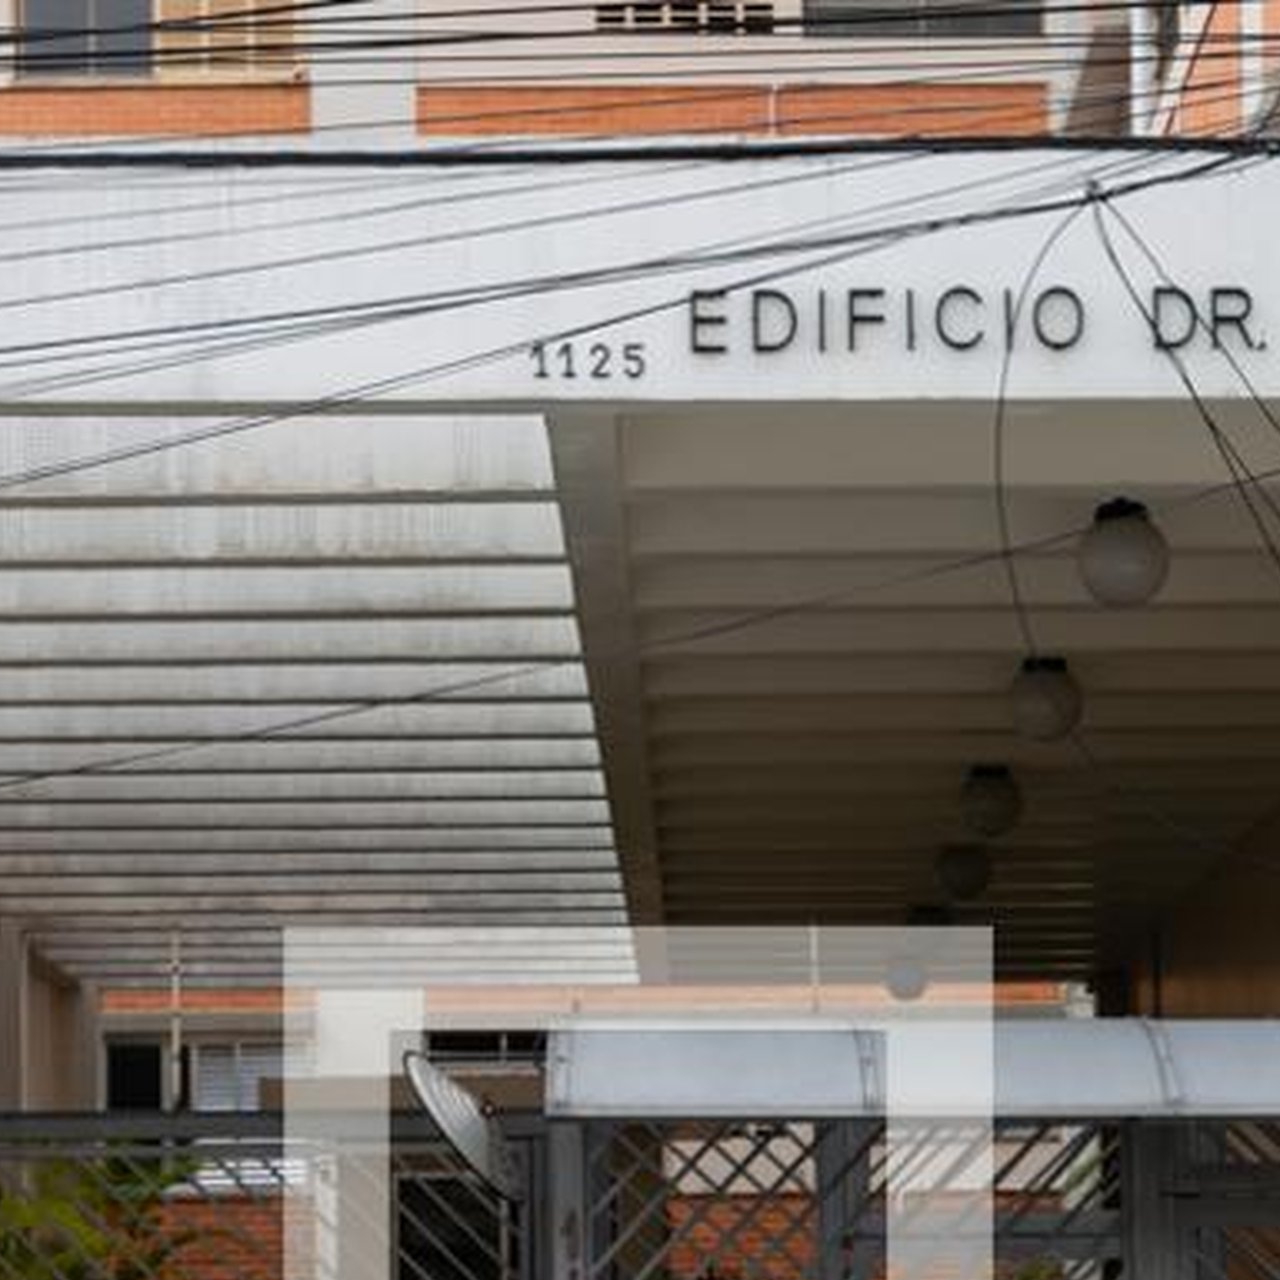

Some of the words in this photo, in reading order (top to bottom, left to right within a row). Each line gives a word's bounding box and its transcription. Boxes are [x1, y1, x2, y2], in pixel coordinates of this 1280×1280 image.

[688, 286, 1086, 355] EDIFICIO
[1152, 286, 1268, 352] DR.
[529, 343, 647, 379] 1125
